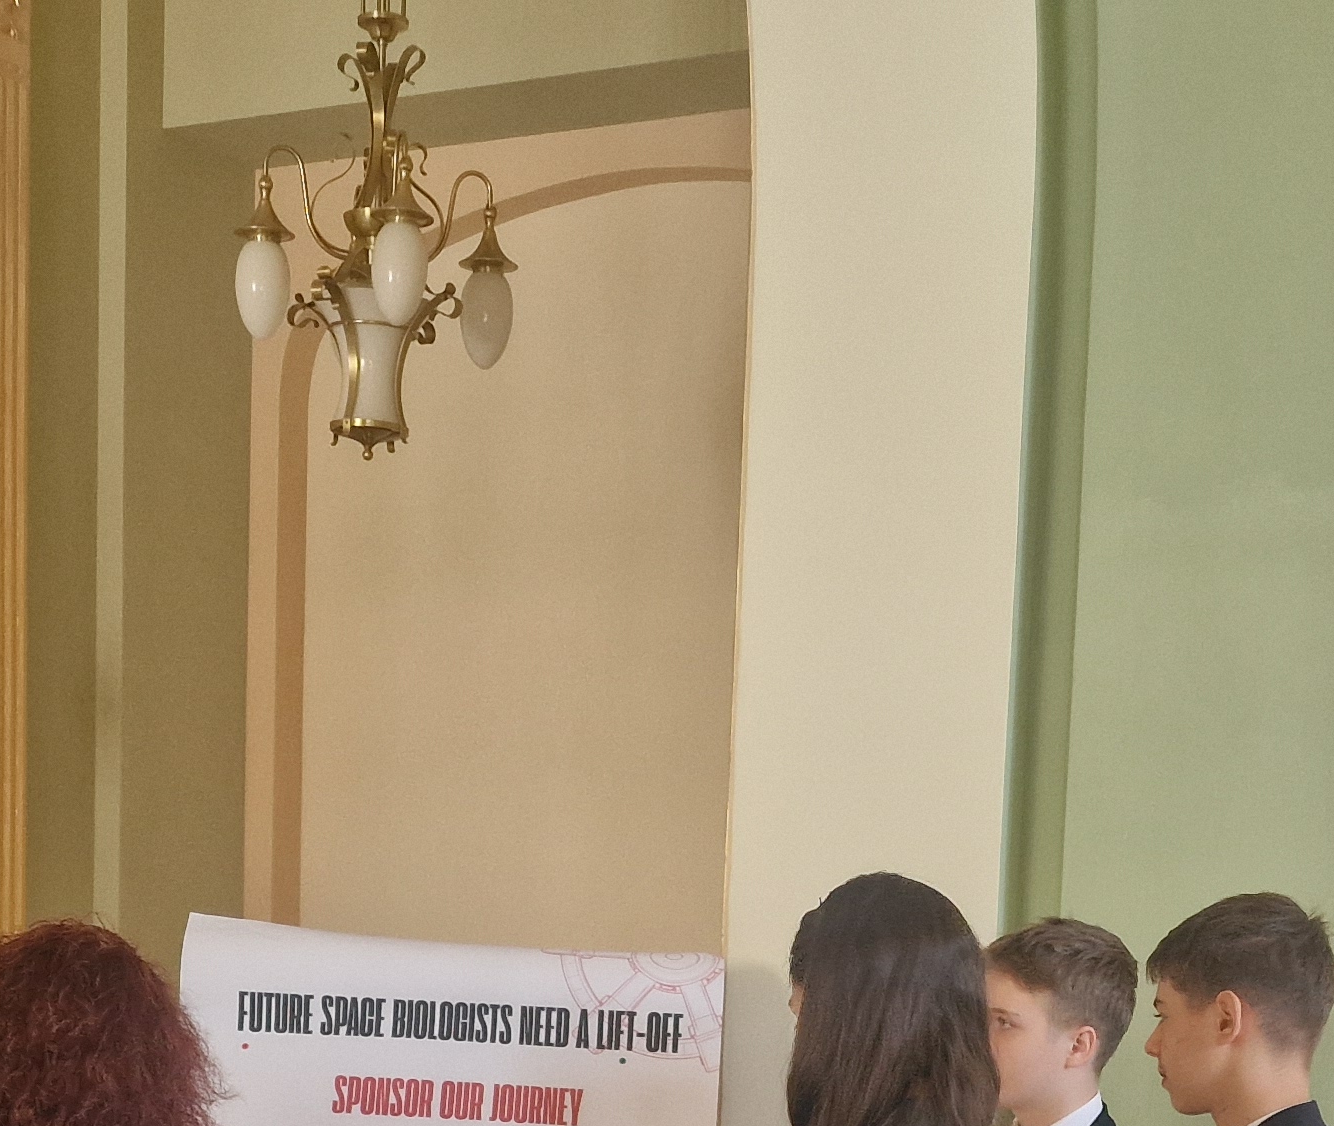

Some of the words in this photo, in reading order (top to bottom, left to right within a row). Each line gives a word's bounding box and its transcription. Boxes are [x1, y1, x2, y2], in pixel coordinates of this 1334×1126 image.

[238, 991, 314, 1034] FUTURE
[320, 995, 385, 1037] SPACE
[392, 999, 512, 1044] BIOLOGISTS
[519, 1006, 570, 1047] NEED
[575, 1009, 590, 1049] A
[596, 1009, 683, 1053] LIFT-OFF
[332, 1075, 434, 1117] SPONSOR
[440, 1081, 484, 1120] OUR
[489, 1084, 583, 1126] JOURNEY
